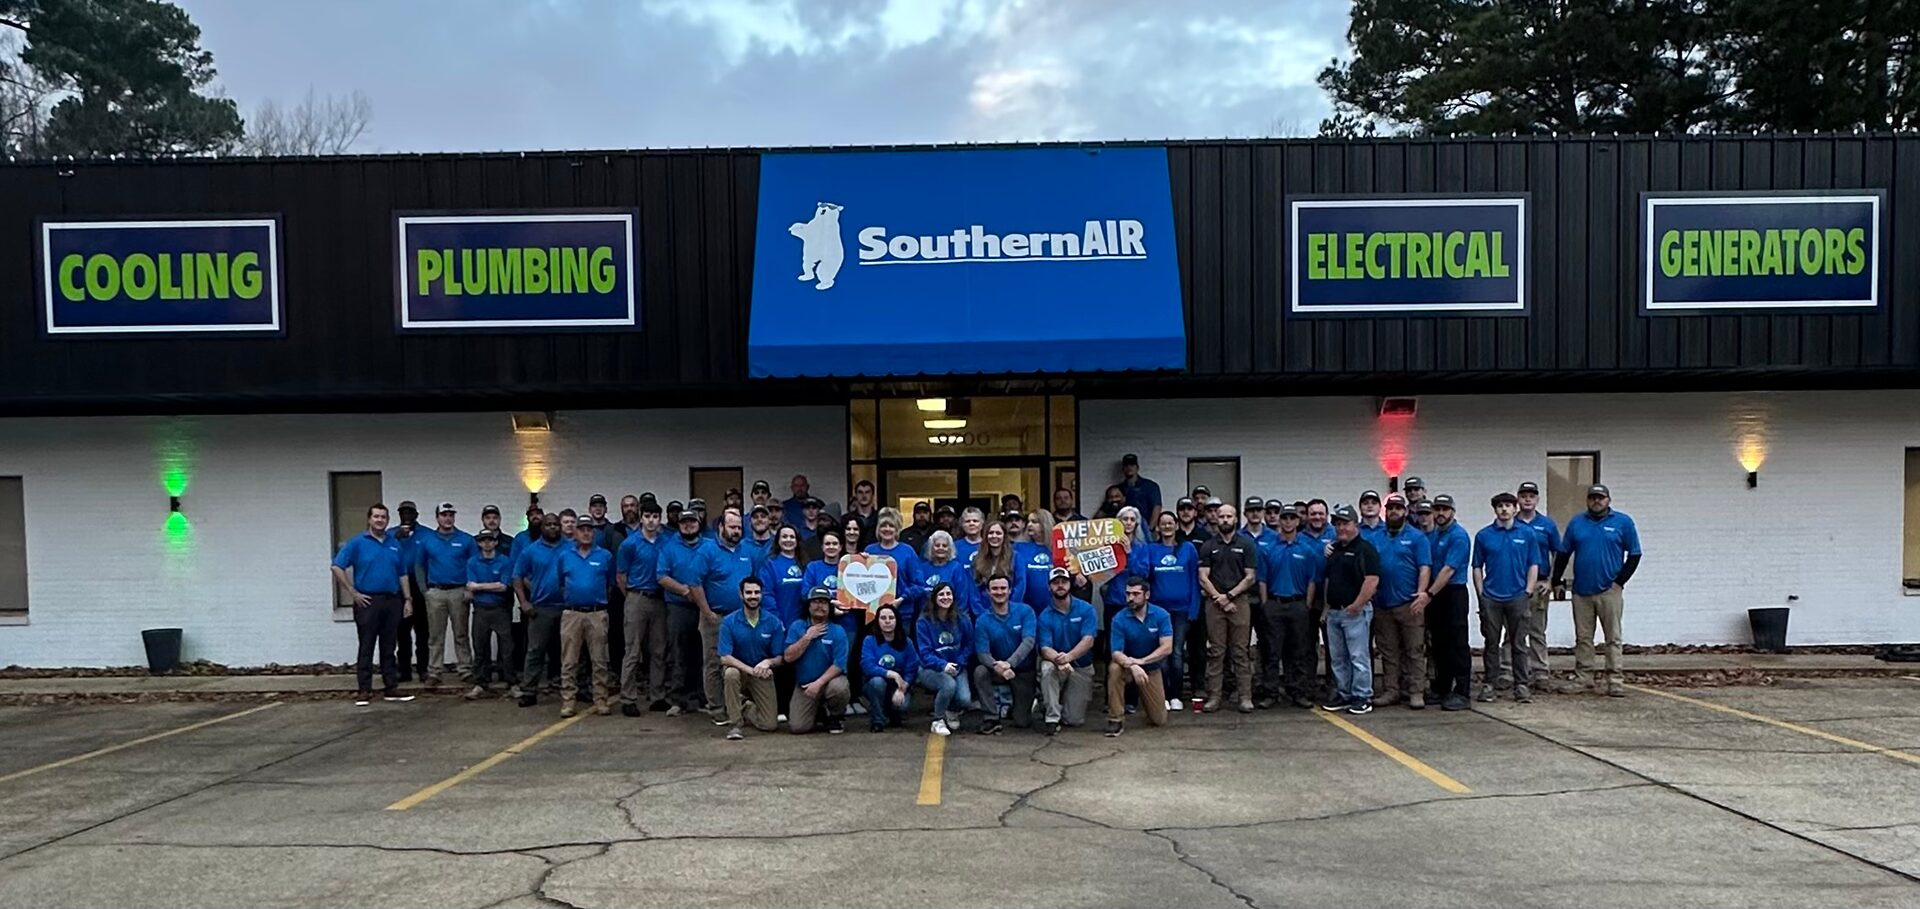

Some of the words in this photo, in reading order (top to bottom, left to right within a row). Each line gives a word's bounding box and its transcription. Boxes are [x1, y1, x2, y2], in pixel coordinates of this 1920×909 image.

[858, 220, 1147, 261] SouthernAIR
[1308, 231, 1509, 280] ELECTRICAL
[1660, 228, 1865, 277] GENERATORS
[59, 252, 262, 301] COOLING
[418, 247, 615, 296] PLUMBING
[938, 432, 990, 447] 9700
[1056, 538, 1082, 549] BEEN
[1084, 535, 1120, 547] LOVED!
[1061, 521, 1114, 539] WE'VE
[1082, 557, 1108, 573] LOVE
